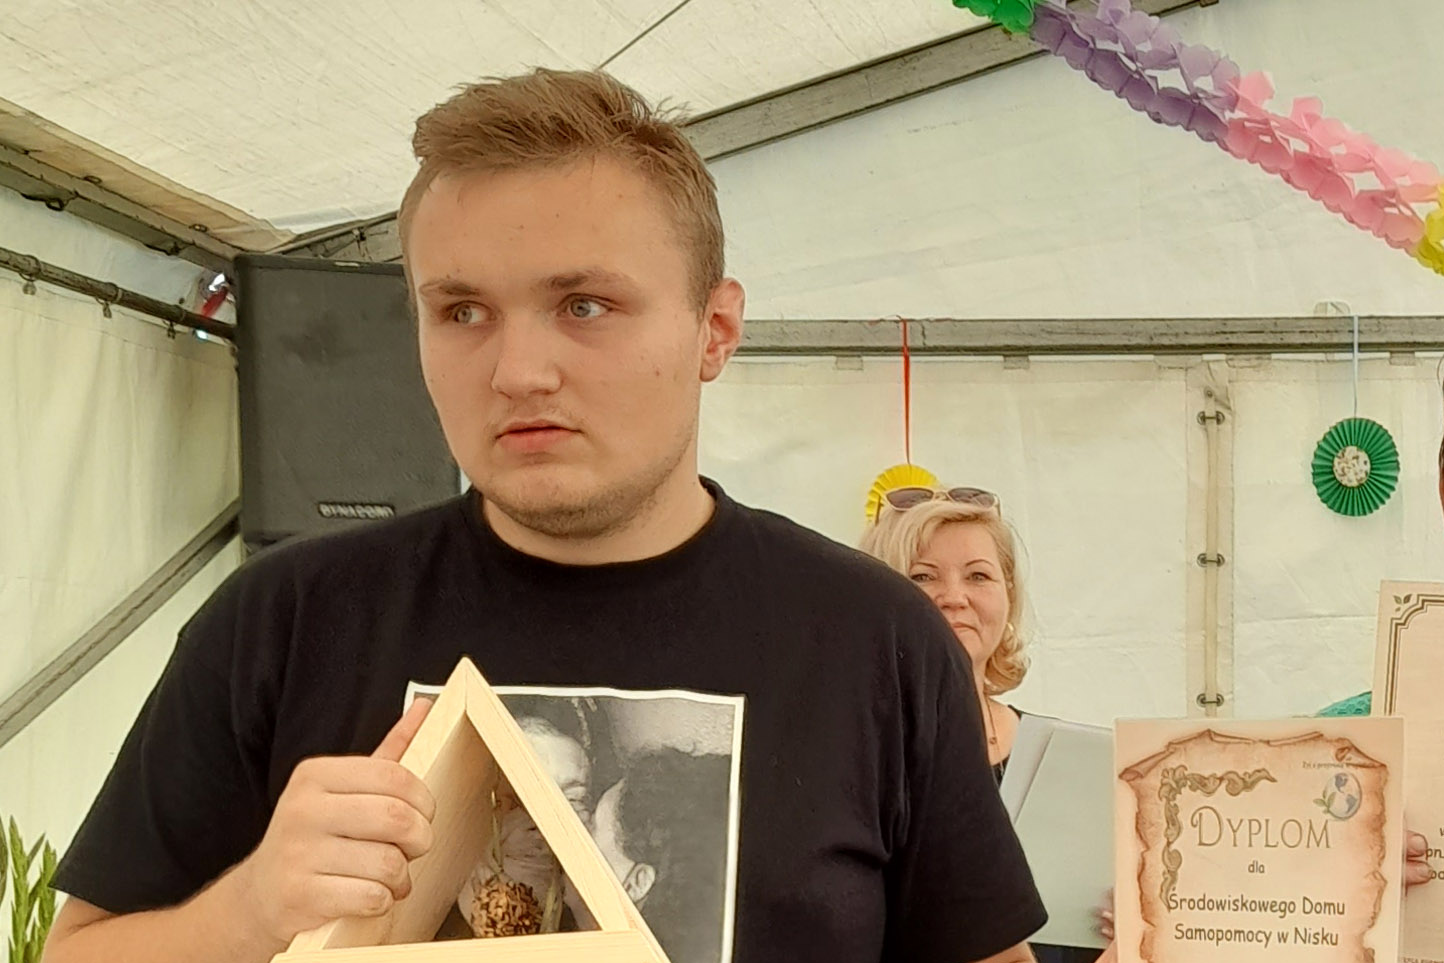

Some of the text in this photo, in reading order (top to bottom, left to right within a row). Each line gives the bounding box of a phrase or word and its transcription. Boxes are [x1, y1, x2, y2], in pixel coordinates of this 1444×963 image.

[1191, 806, 1331, 848] DYPLOM
[1248, 861, 1265, 874] dla
[1169, 887, 1345, 918] Środowiskowego Domu
[1174, 923, 1339, 948] Samopomocy w Nisku
